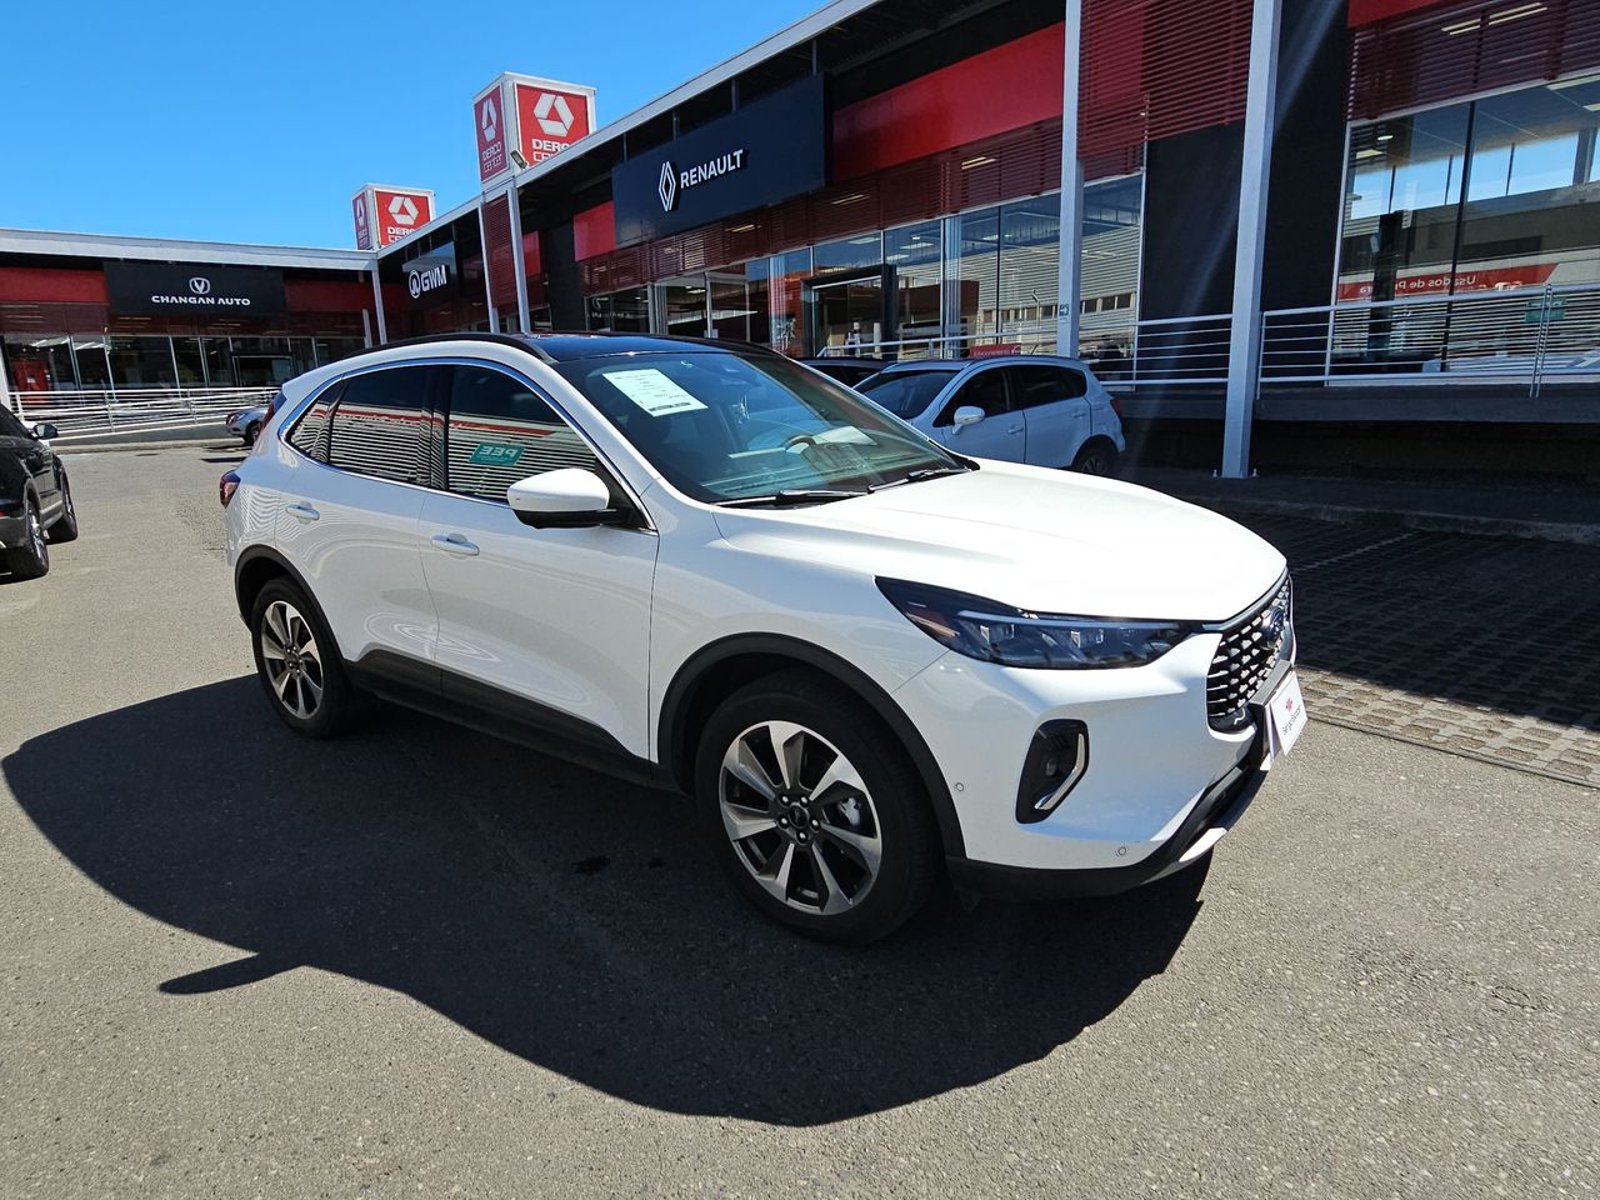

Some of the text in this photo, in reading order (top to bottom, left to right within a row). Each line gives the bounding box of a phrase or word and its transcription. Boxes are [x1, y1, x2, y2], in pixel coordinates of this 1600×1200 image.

[532, 138, 570, 152] DERC
[680, 149, 744, 189] RENAULT
[420, 264, 447, 292] GWM
[151, 295, 251, 306] CHANGAN AUTO
